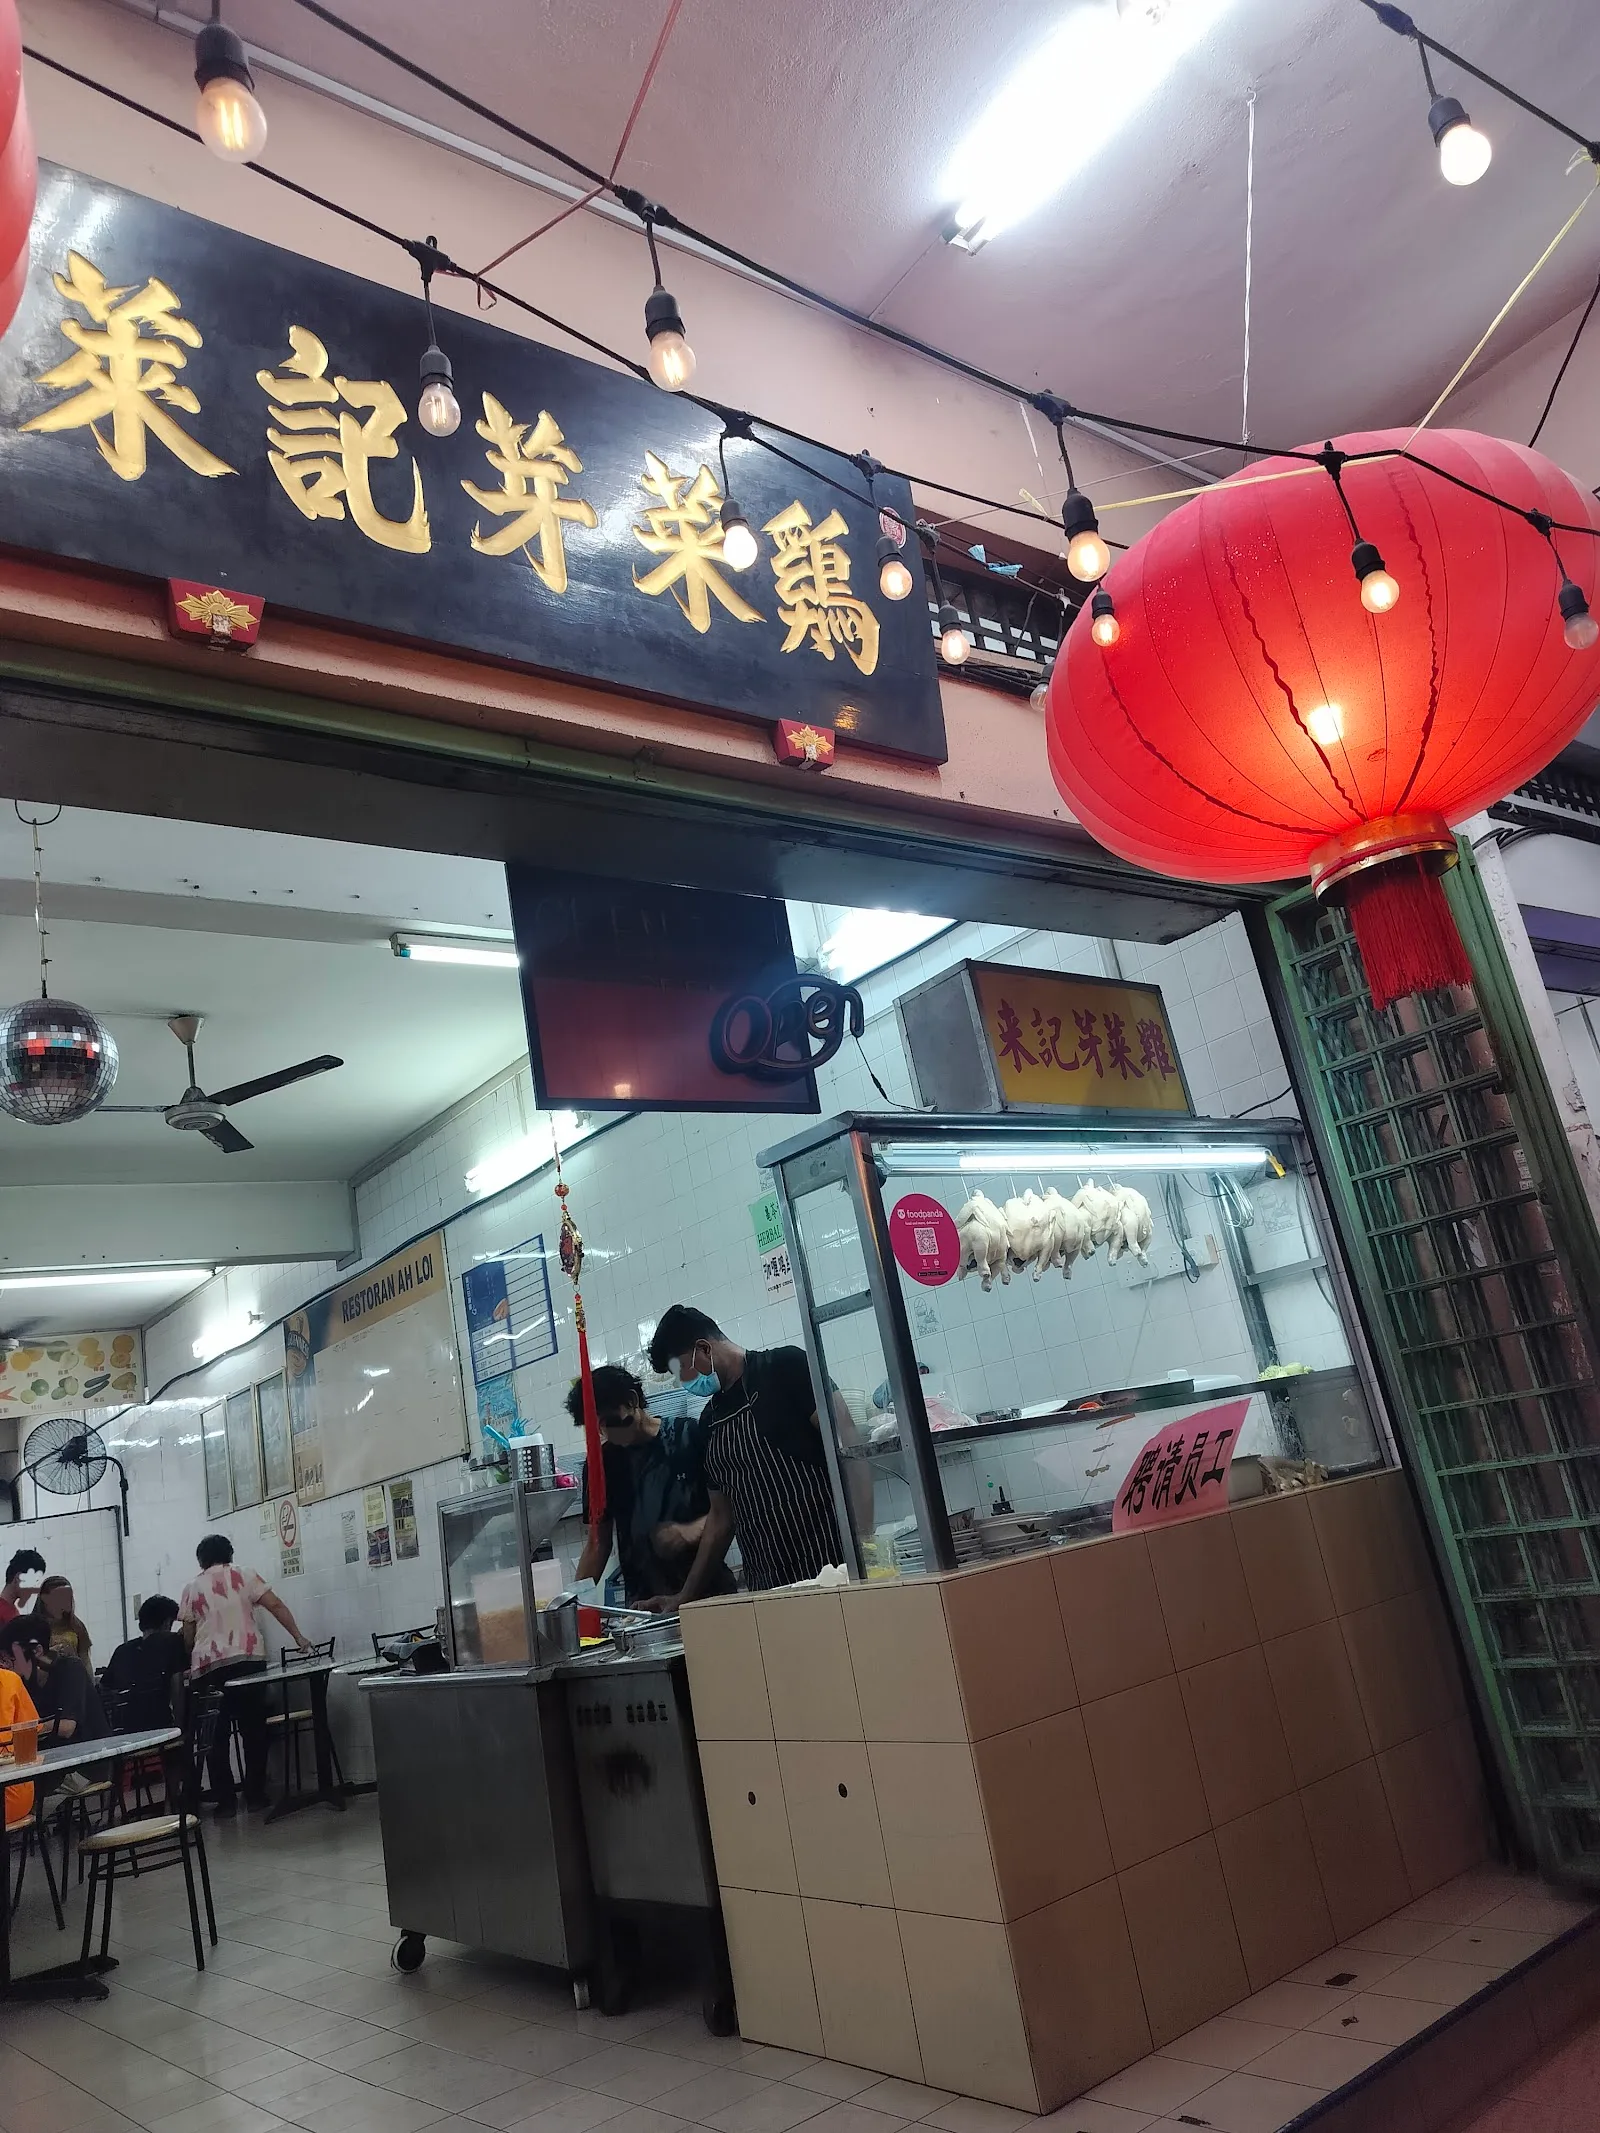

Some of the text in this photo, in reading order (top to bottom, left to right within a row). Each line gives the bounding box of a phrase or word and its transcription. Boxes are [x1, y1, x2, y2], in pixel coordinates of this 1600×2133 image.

[757, 1224, 783, 1248] HERBAL
[906, 1209, 943, 1220] foodpanda
[341, 1253, 434, 1324] RESTORAN AH LOI
[1121, 1428, 1235, 1517] 聘请员工
